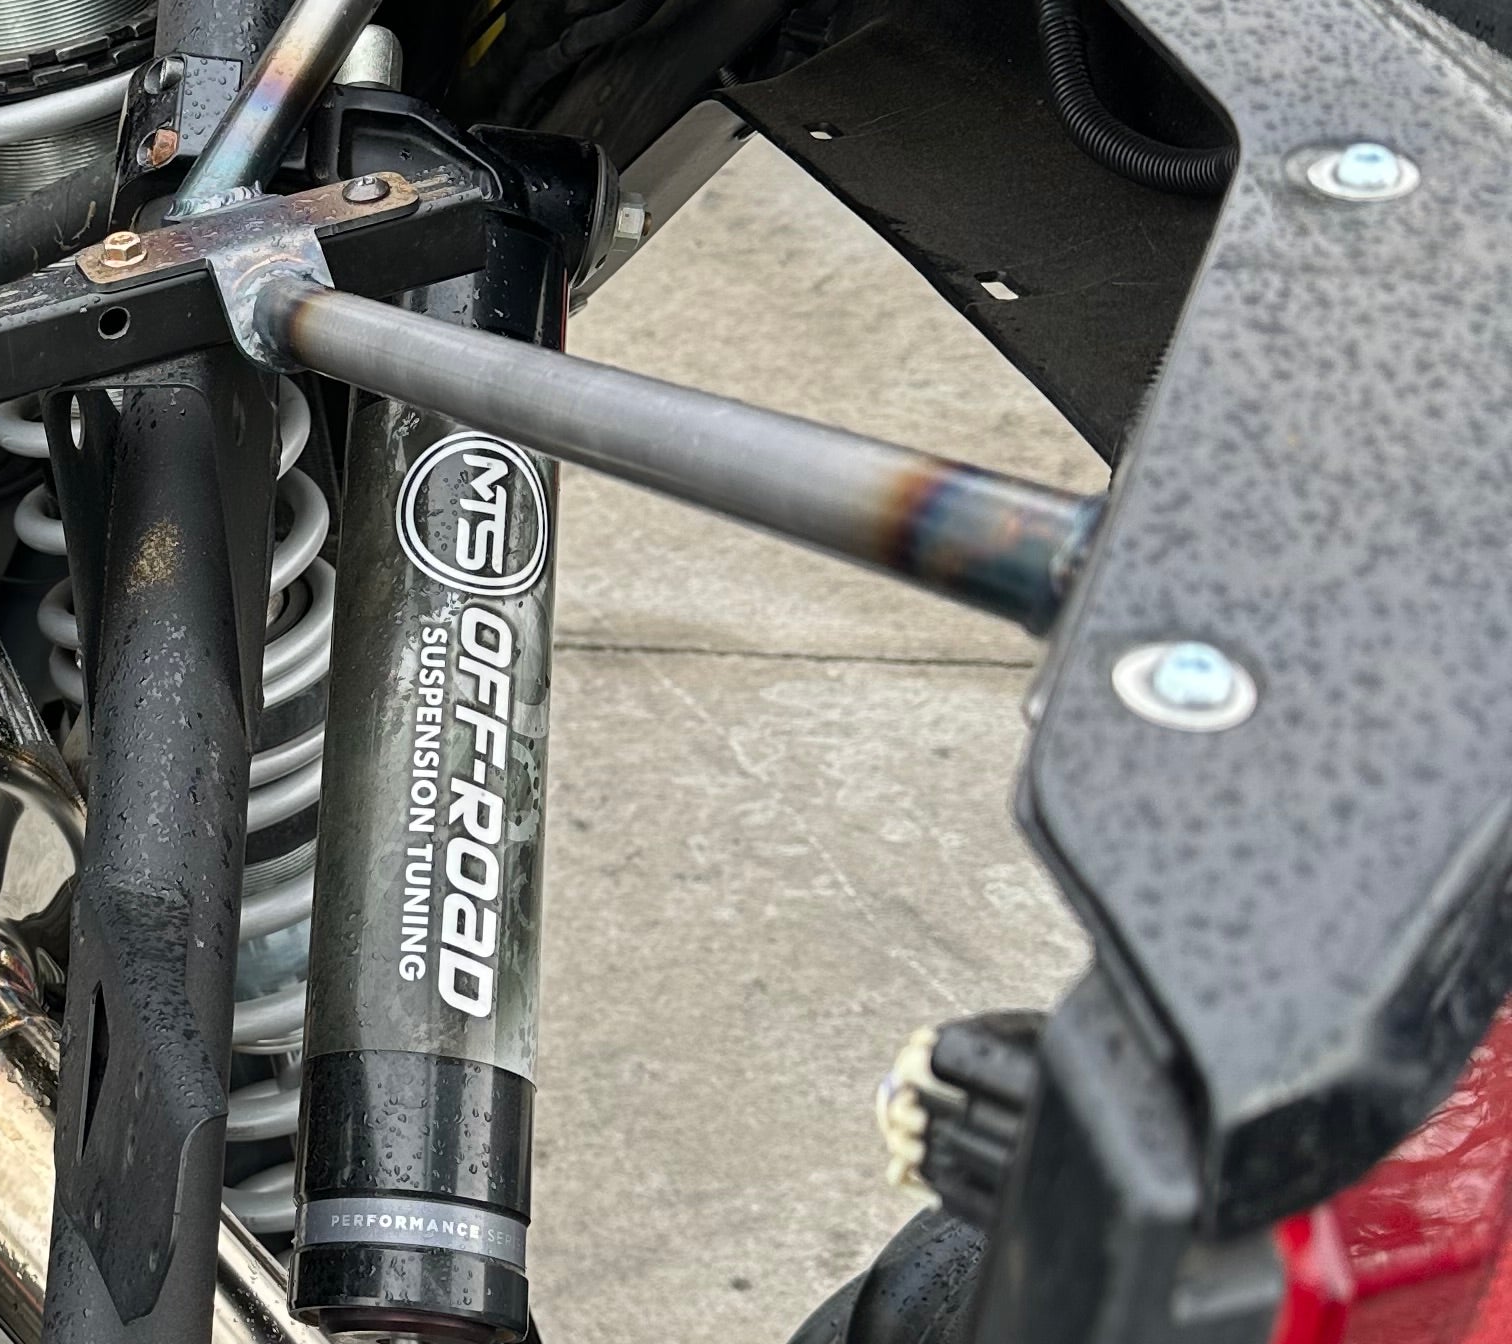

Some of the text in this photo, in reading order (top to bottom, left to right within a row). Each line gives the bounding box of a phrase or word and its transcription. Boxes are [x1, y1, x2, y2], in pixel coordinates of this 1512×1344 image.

[456, 452, 510, 576] MTS
[398, 624, 449, 982] SUSPENSION TUNING
[331, 1213, 481, 1239] PERFORMANCE
